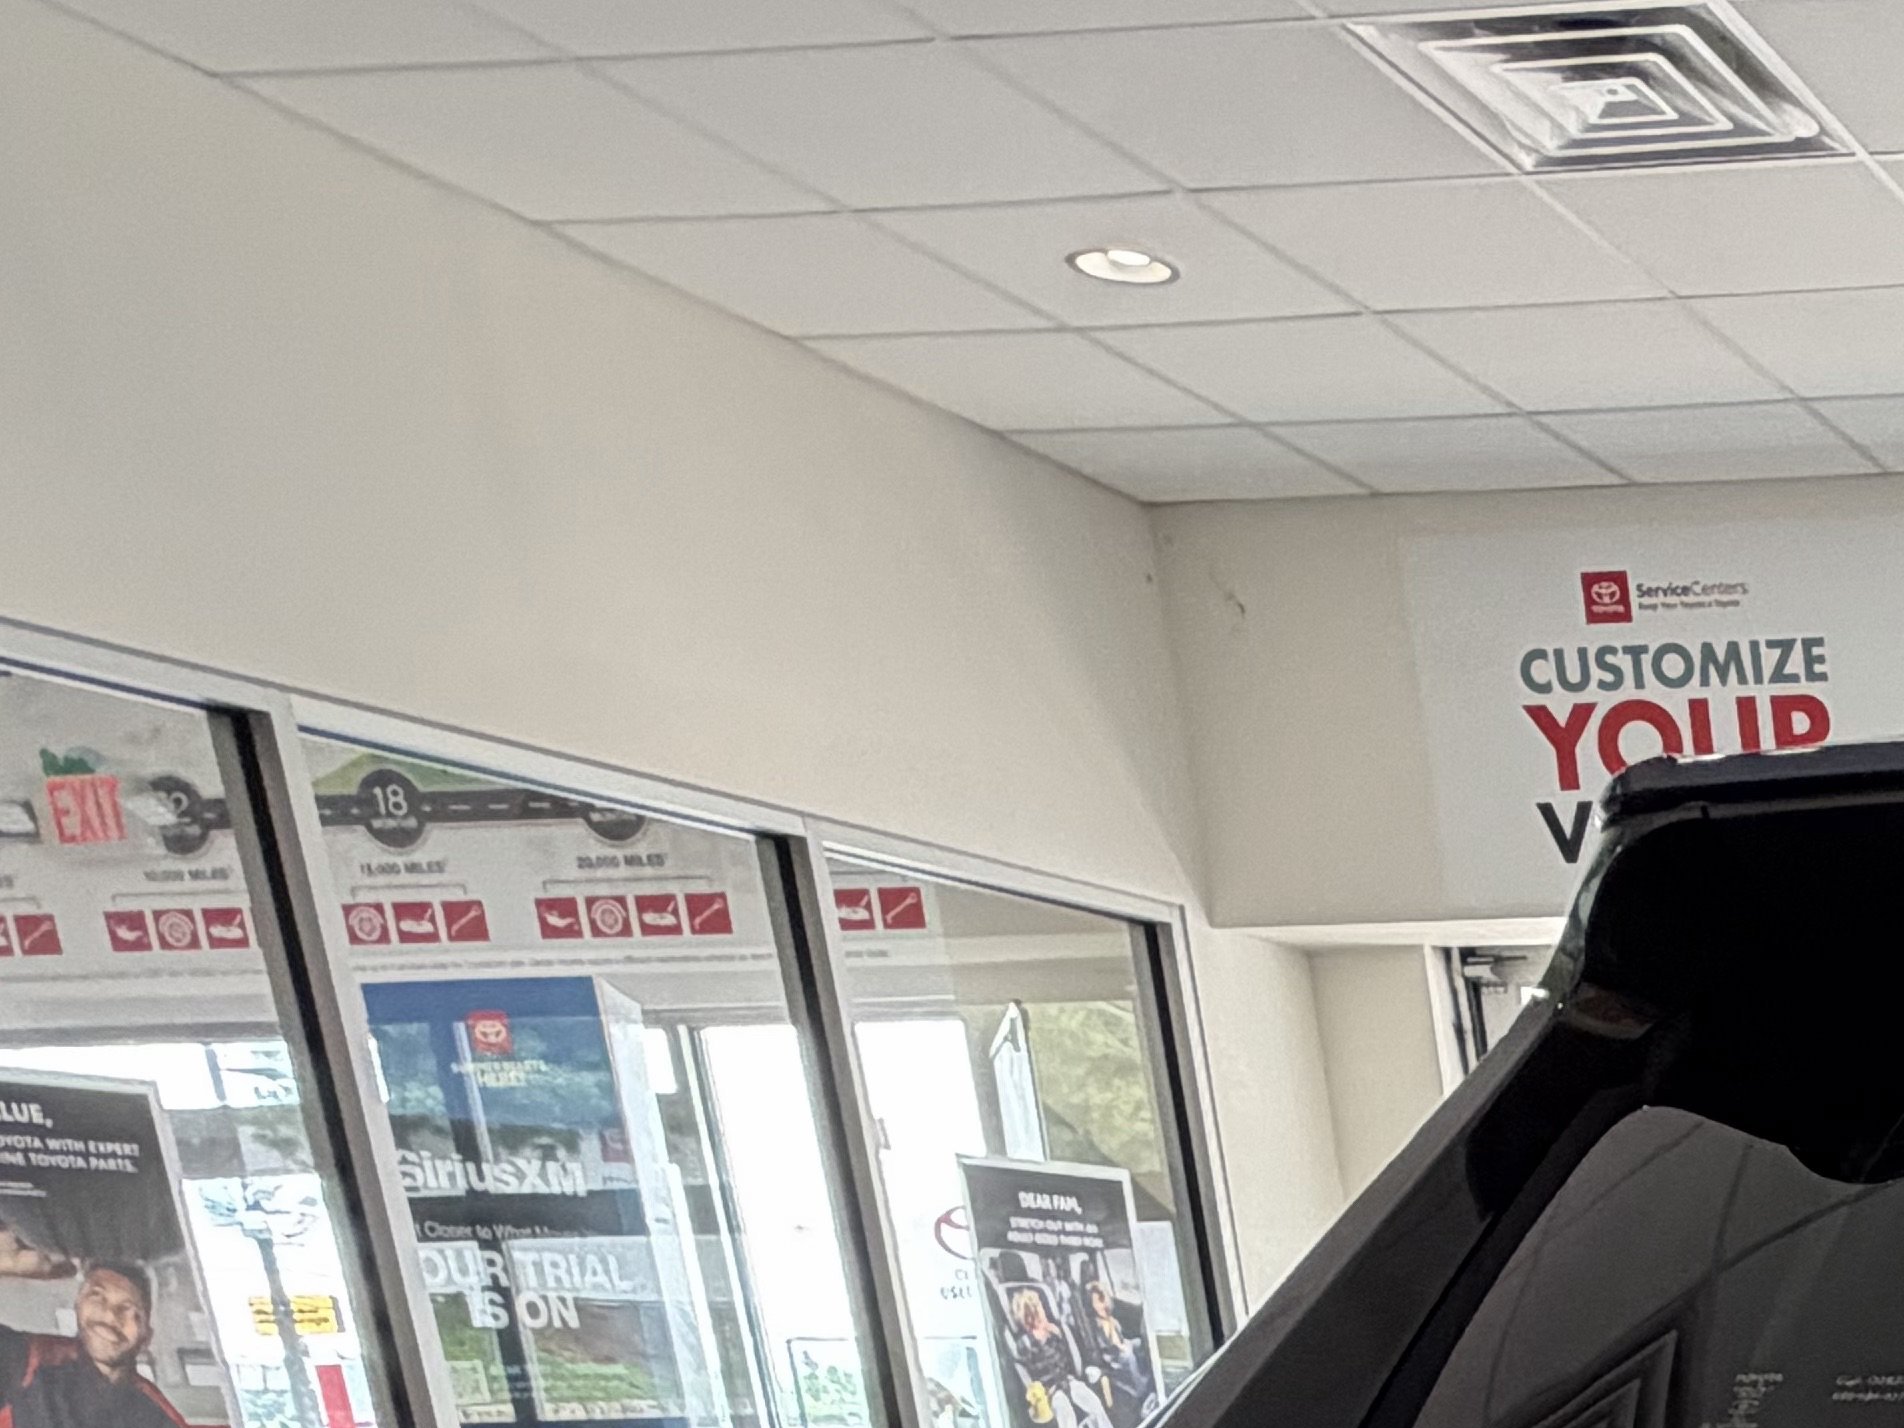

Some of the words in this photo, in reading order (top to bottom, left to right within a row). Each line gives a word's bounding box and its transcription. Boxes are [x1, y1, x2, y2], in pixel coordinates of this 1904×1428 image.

[1636, 580, 1749, 599] ServiceCenters
[1519, 636, 1829, 695] CUSTOMIZE
[1521, 694, 1831, 792] YOUR
[372, 784, 408, 817] 18
[0, 1134, 44, 1150] OYOTA
[421, 1249, 510, 1288] OUR
[513, 1249, 634, 1291] TRIAL
[518, 1290, 580, 1329] ON
